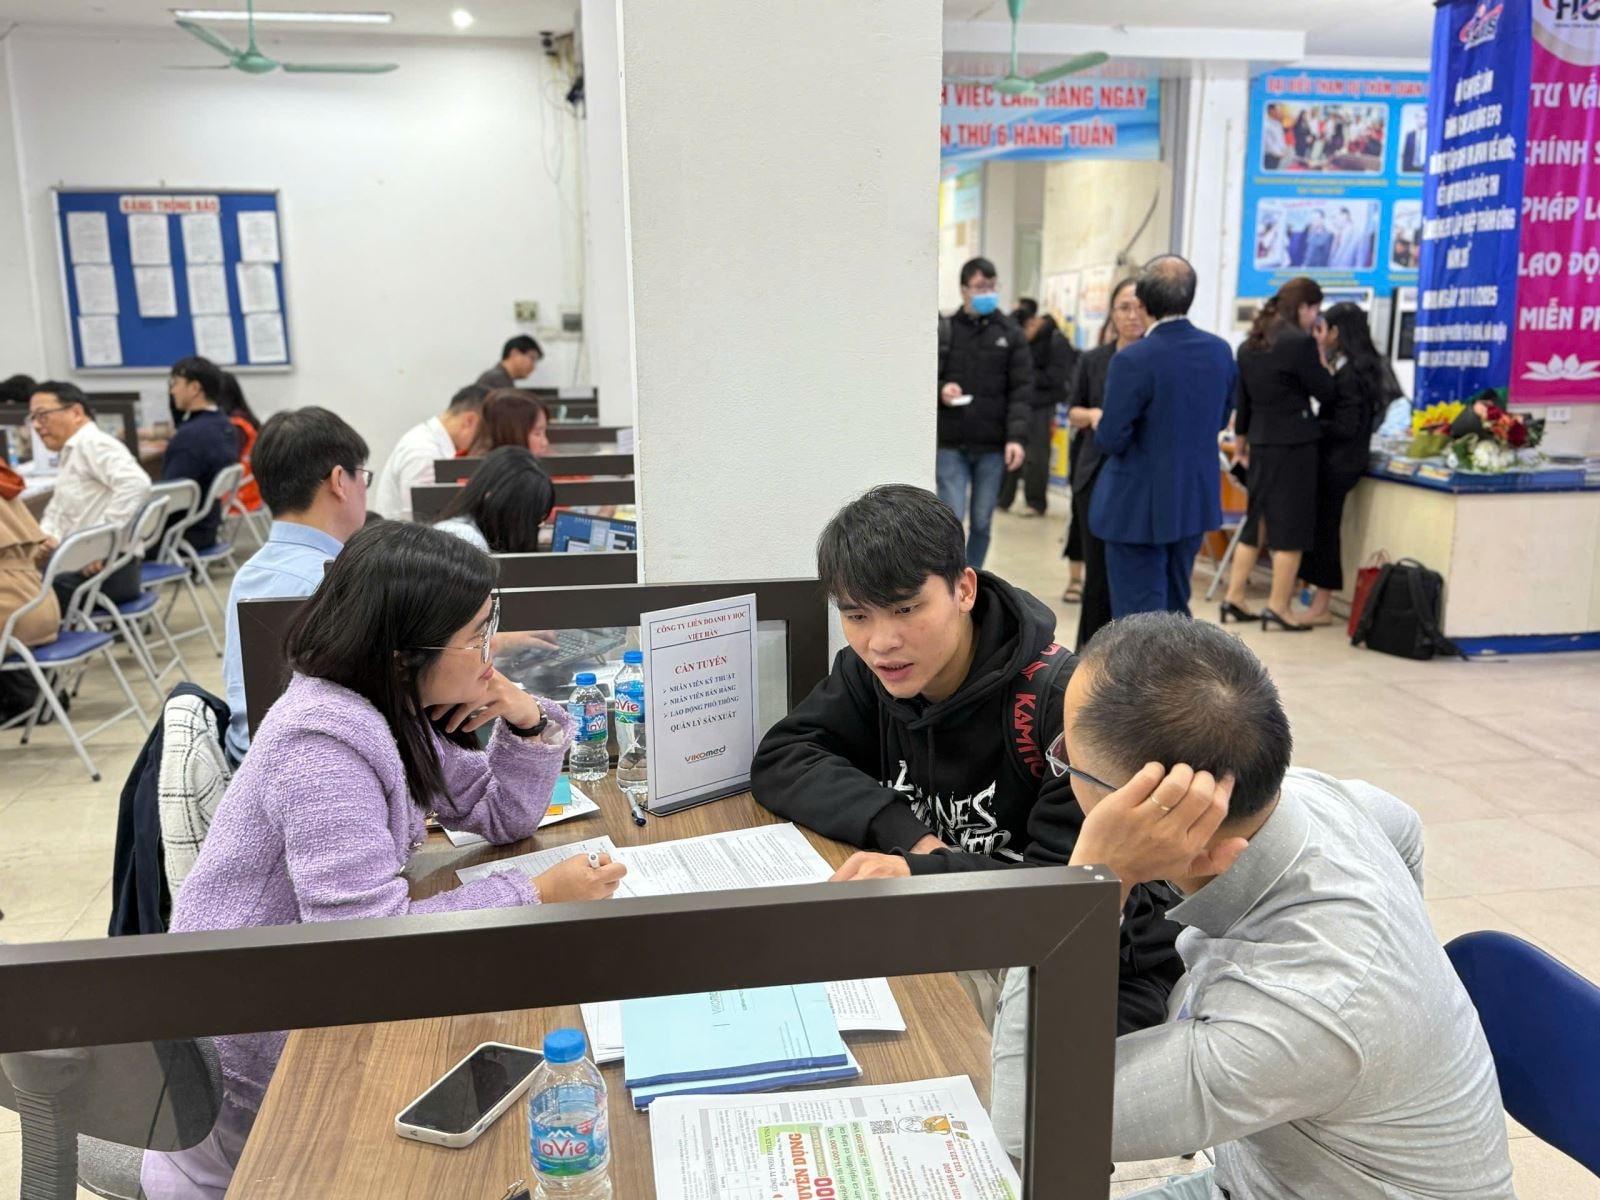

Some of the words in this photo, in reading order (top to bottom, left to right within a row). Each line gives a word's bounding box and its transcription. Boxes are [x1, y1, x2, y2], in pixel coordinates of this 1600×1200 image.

[1099, 80, 1147, 108] NGÀY
[1530, 81, 1564, 108] TƯ
[1568, 72, 1600, 110] VẤ
[957, 119, 993, 145] THỨ
[997, 123, 1008, 146] 6
[1013, 117, 1063, 146] HÀNG
[1068, 115, 1115, 146] TUẦN
[1517, 251, 1562, 278] LAO
[1568, 246, 1600, 283] ĐỘ
[1519, 297, 1574, 331] MIỄN
[656, 624, 676, 634] CÔNG
[687, 618, 702, 628] LIÊN
[703, 615, 726, 625] DOANH
[732, 611, 746, 620] HỌC
[687, 632, 703, 641] VIỆT
[675, 661, 695, 675] CẦN
[696, 655, 727, 670] TUYỂN
[669, 682, 688, 692] NHÂN
[688, 679, 704, 688] VIÊN
[670, 695, 688, 705] NHÂN
[689, 691, 704, 700] VIÊN
[670, 708, 684, 717] LAO
[684, 703, 703, 714] ĐỘNG
[670, 721, 691, 732] QUẢN
[788, 1132, 808, 1166] DỤNG
[789, 1168, 813, 1200] UYỂN
[814, 1177, 836, 1200] 00
